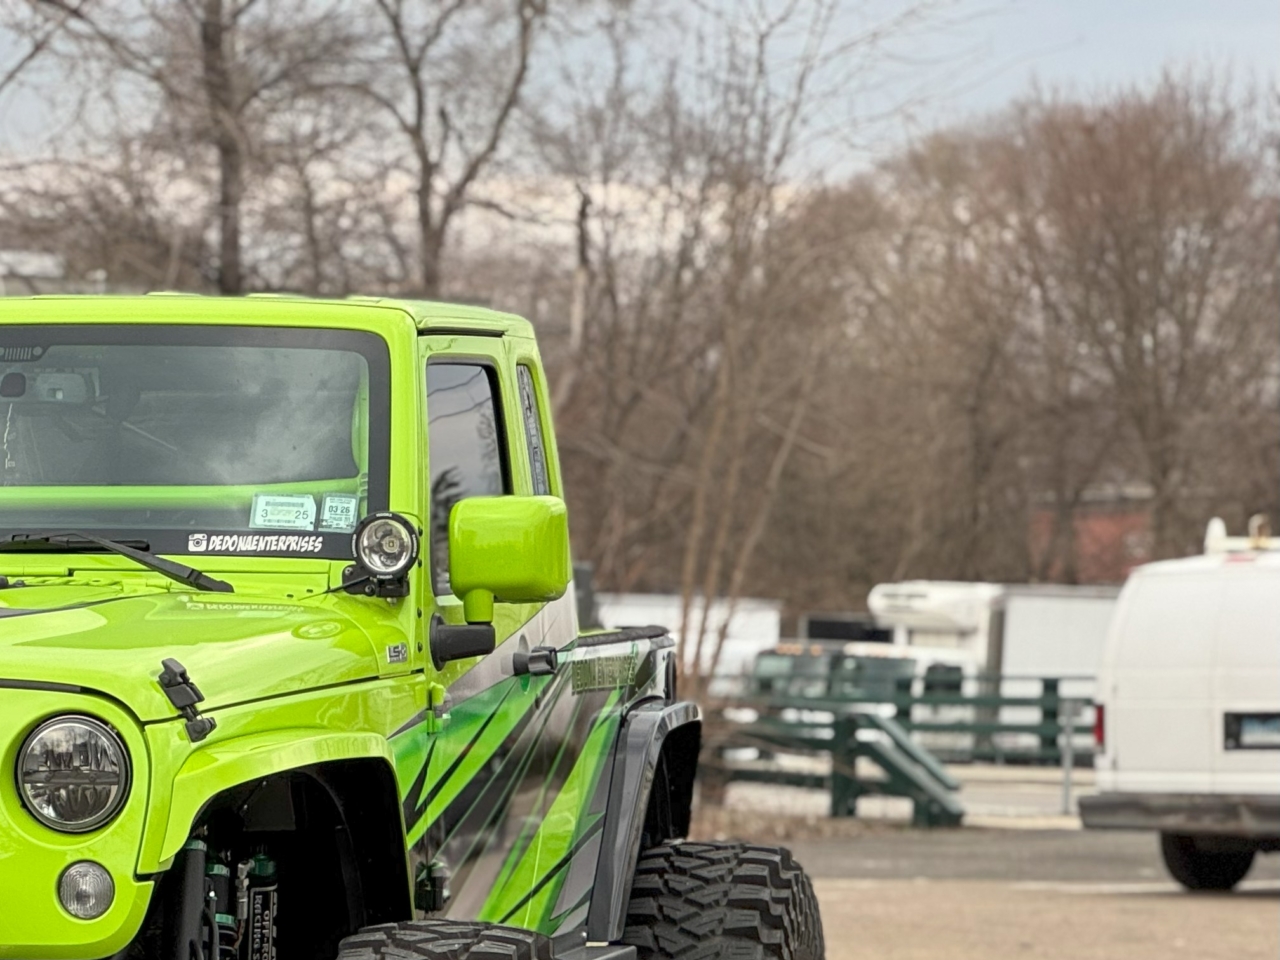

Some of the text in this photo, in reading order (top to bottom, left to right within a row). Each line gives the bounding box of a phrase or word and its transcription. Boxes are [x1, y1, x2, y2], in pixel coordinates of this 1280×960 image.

[261, 508, 309, 520] 3 25
[328, 505, 338, 513] 03
